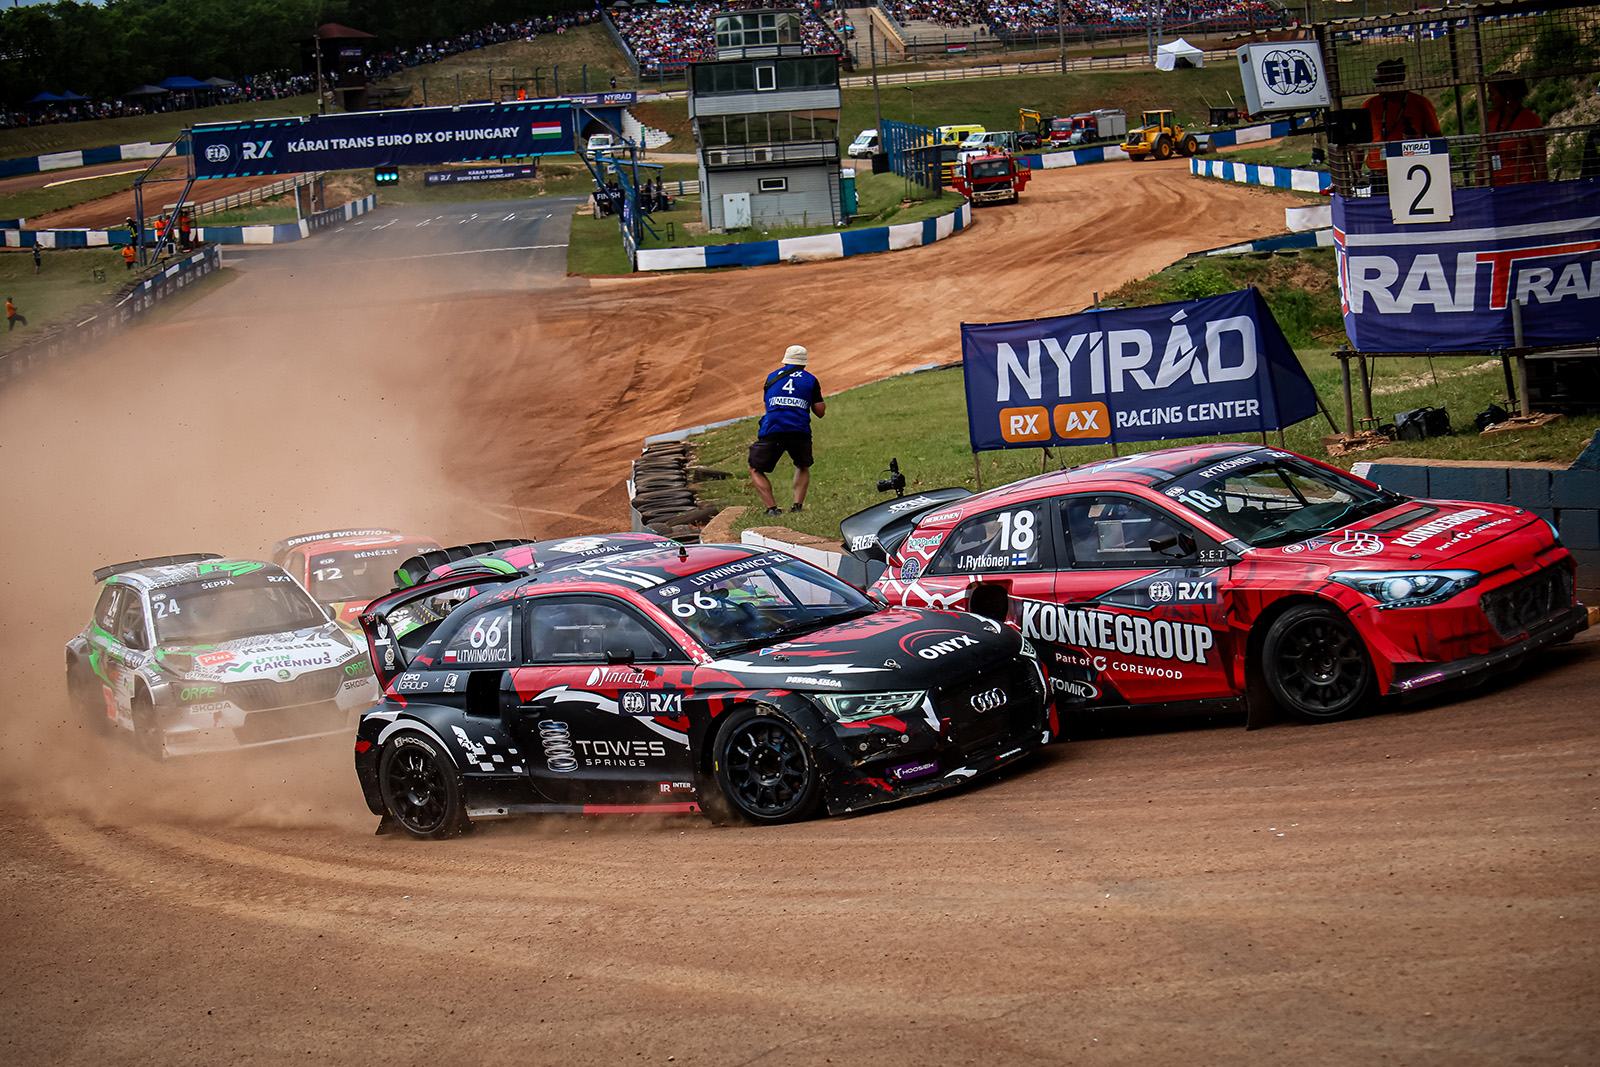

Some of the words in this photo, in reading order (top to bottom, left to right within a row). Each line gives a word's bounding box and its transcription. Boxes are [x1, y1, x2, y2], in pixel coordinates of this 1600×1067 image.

[288, 138, 329, 153] KÁRAI
[331, 136, 375, 150] TRANS
[377, 133, 413, 148] EURO
[415, 132, 433, 145] RX
[435, 131, 454, 143] OF
[455, 126, 520, 142] HUNGARY
[243, 140, 274, 160] RX
[597, 192, 621, 200] FINSH
[1407, 164, 1434, 216] 2
[782, 378, 795, 395] 4
[1187, 399, 1261, 422] CENTER
[1010, 414, 1039, 436] RX
[1065, 409, 1100, 432] AX
[1199, 456, 1257, 479] RYTKÖNEN
[1178, 490, 1223, 513] 18
[997, 510, 1035, 551] 18
[1390, 509, 1495, 547] KONNEGROUP
[288, 533, 331, 546] DRIVING
[333, 529, 390, 538] EVOLUTION
[353, 548, 399, 559] BÉNÉZET
[579, 545, 624, 557] TREPAK
[957, 554, 1010, 571] J.Rytkönen
[312, 568, 344, 582] 12
[690, 558, 772, 586] LITWINOWICZ
[201, 578, 235, 590] SEPPÄ
[1177, 582, 1213, 601] RX1
[153, 598, 181, 620] 24
[671, 591, 718, 618] 66
[470, 616, 503, 648] 66
[1021, 600, 1213, 664] KONNEGROUP
[242, 641, 332, 656] Katsastus
[457, 648, 507, 662] LITWINOWICZ
[918, 634, 980, 660] ONYX
[202, 653, 230, 665] Plus
[252, 656, 332, 673] RAKENNUS
[1055, 653, 1077, 665] Part
[1079, 657, 1091, 666] of
[1112, 661, 1183, 680] COREWOOD
[180, 686, 217, 702] ORPE
[400, 681, 429, 690] GROUP
[650, 694, 683, 712] RX1
[575, 740, 666, 757] TOWES
[585, 758, 647, 767] SPRINGS
[660, 783, 671, 792] IR
